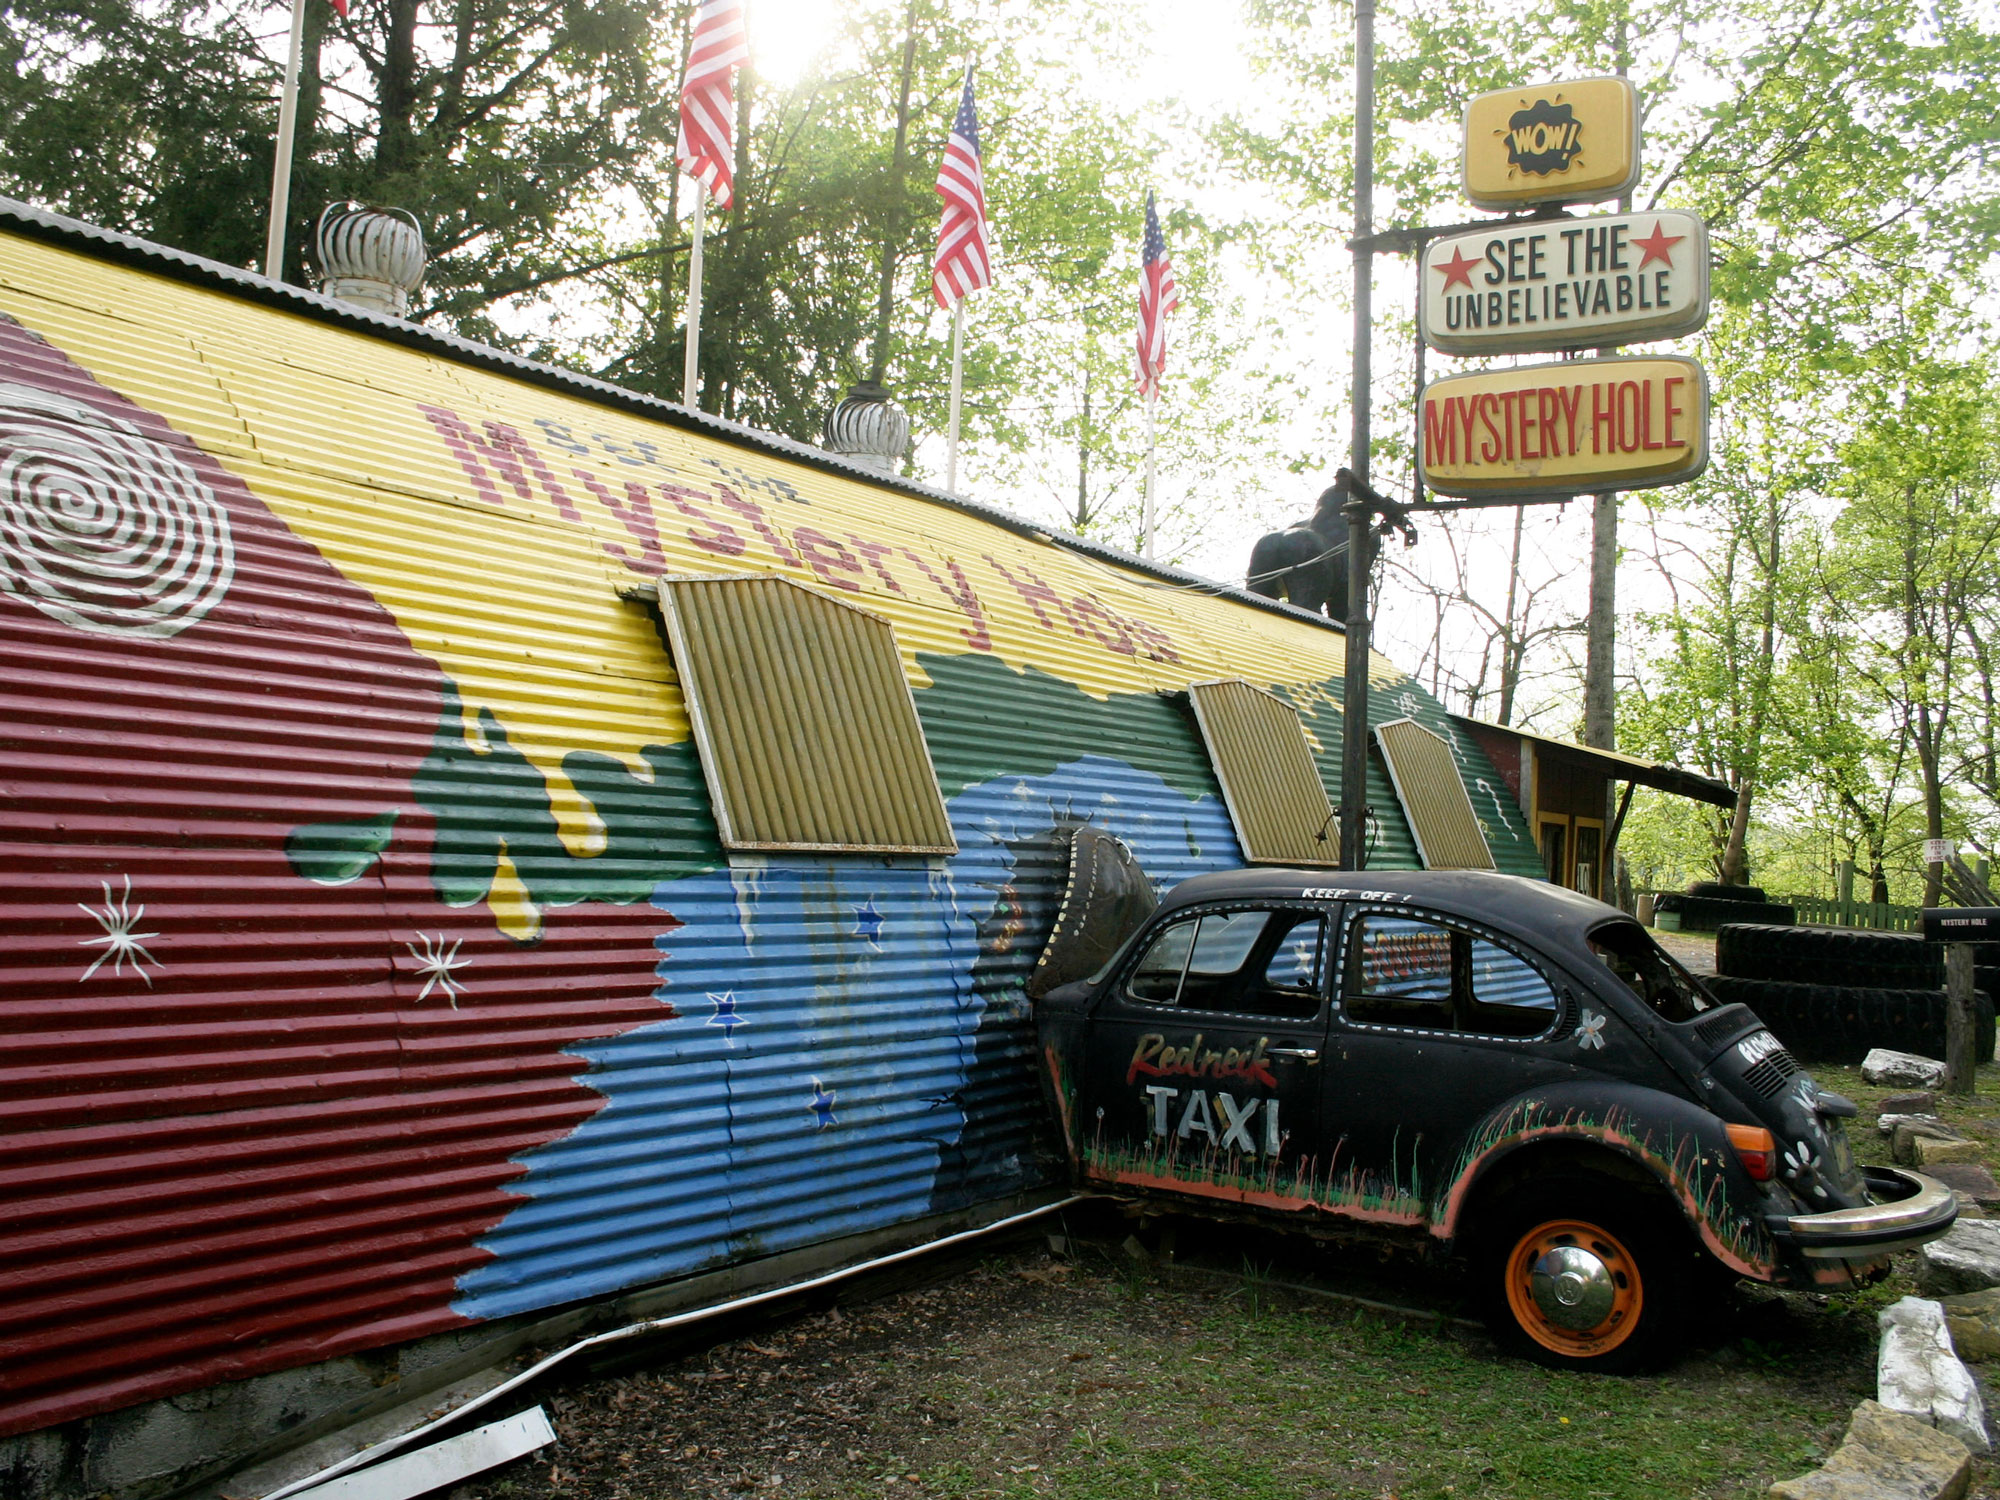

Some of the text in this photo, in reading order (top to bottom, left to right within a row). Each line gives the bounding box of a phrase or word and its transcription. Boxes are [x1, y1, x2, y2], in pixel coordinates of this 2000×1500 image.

[1511, 121, 1577, 160] WOW!
[1484, 224, 1629, 285] SEE THE
[1445, 270, 1670, 331] UNBELIEVABLE
[533, 417, 677, 474] SEE
[1424, 377, 1685, 468] MYSTERY HOLE
[416, 402, 1182, 666] Mystery Hole
[1302, 887, 1350, 900] KEEP
[1971, 918, 1988, 926] HOLE
[1126, 1032, 1278, 1089] Redneck
[1146, 1083, 1281, 1157] TAXI
